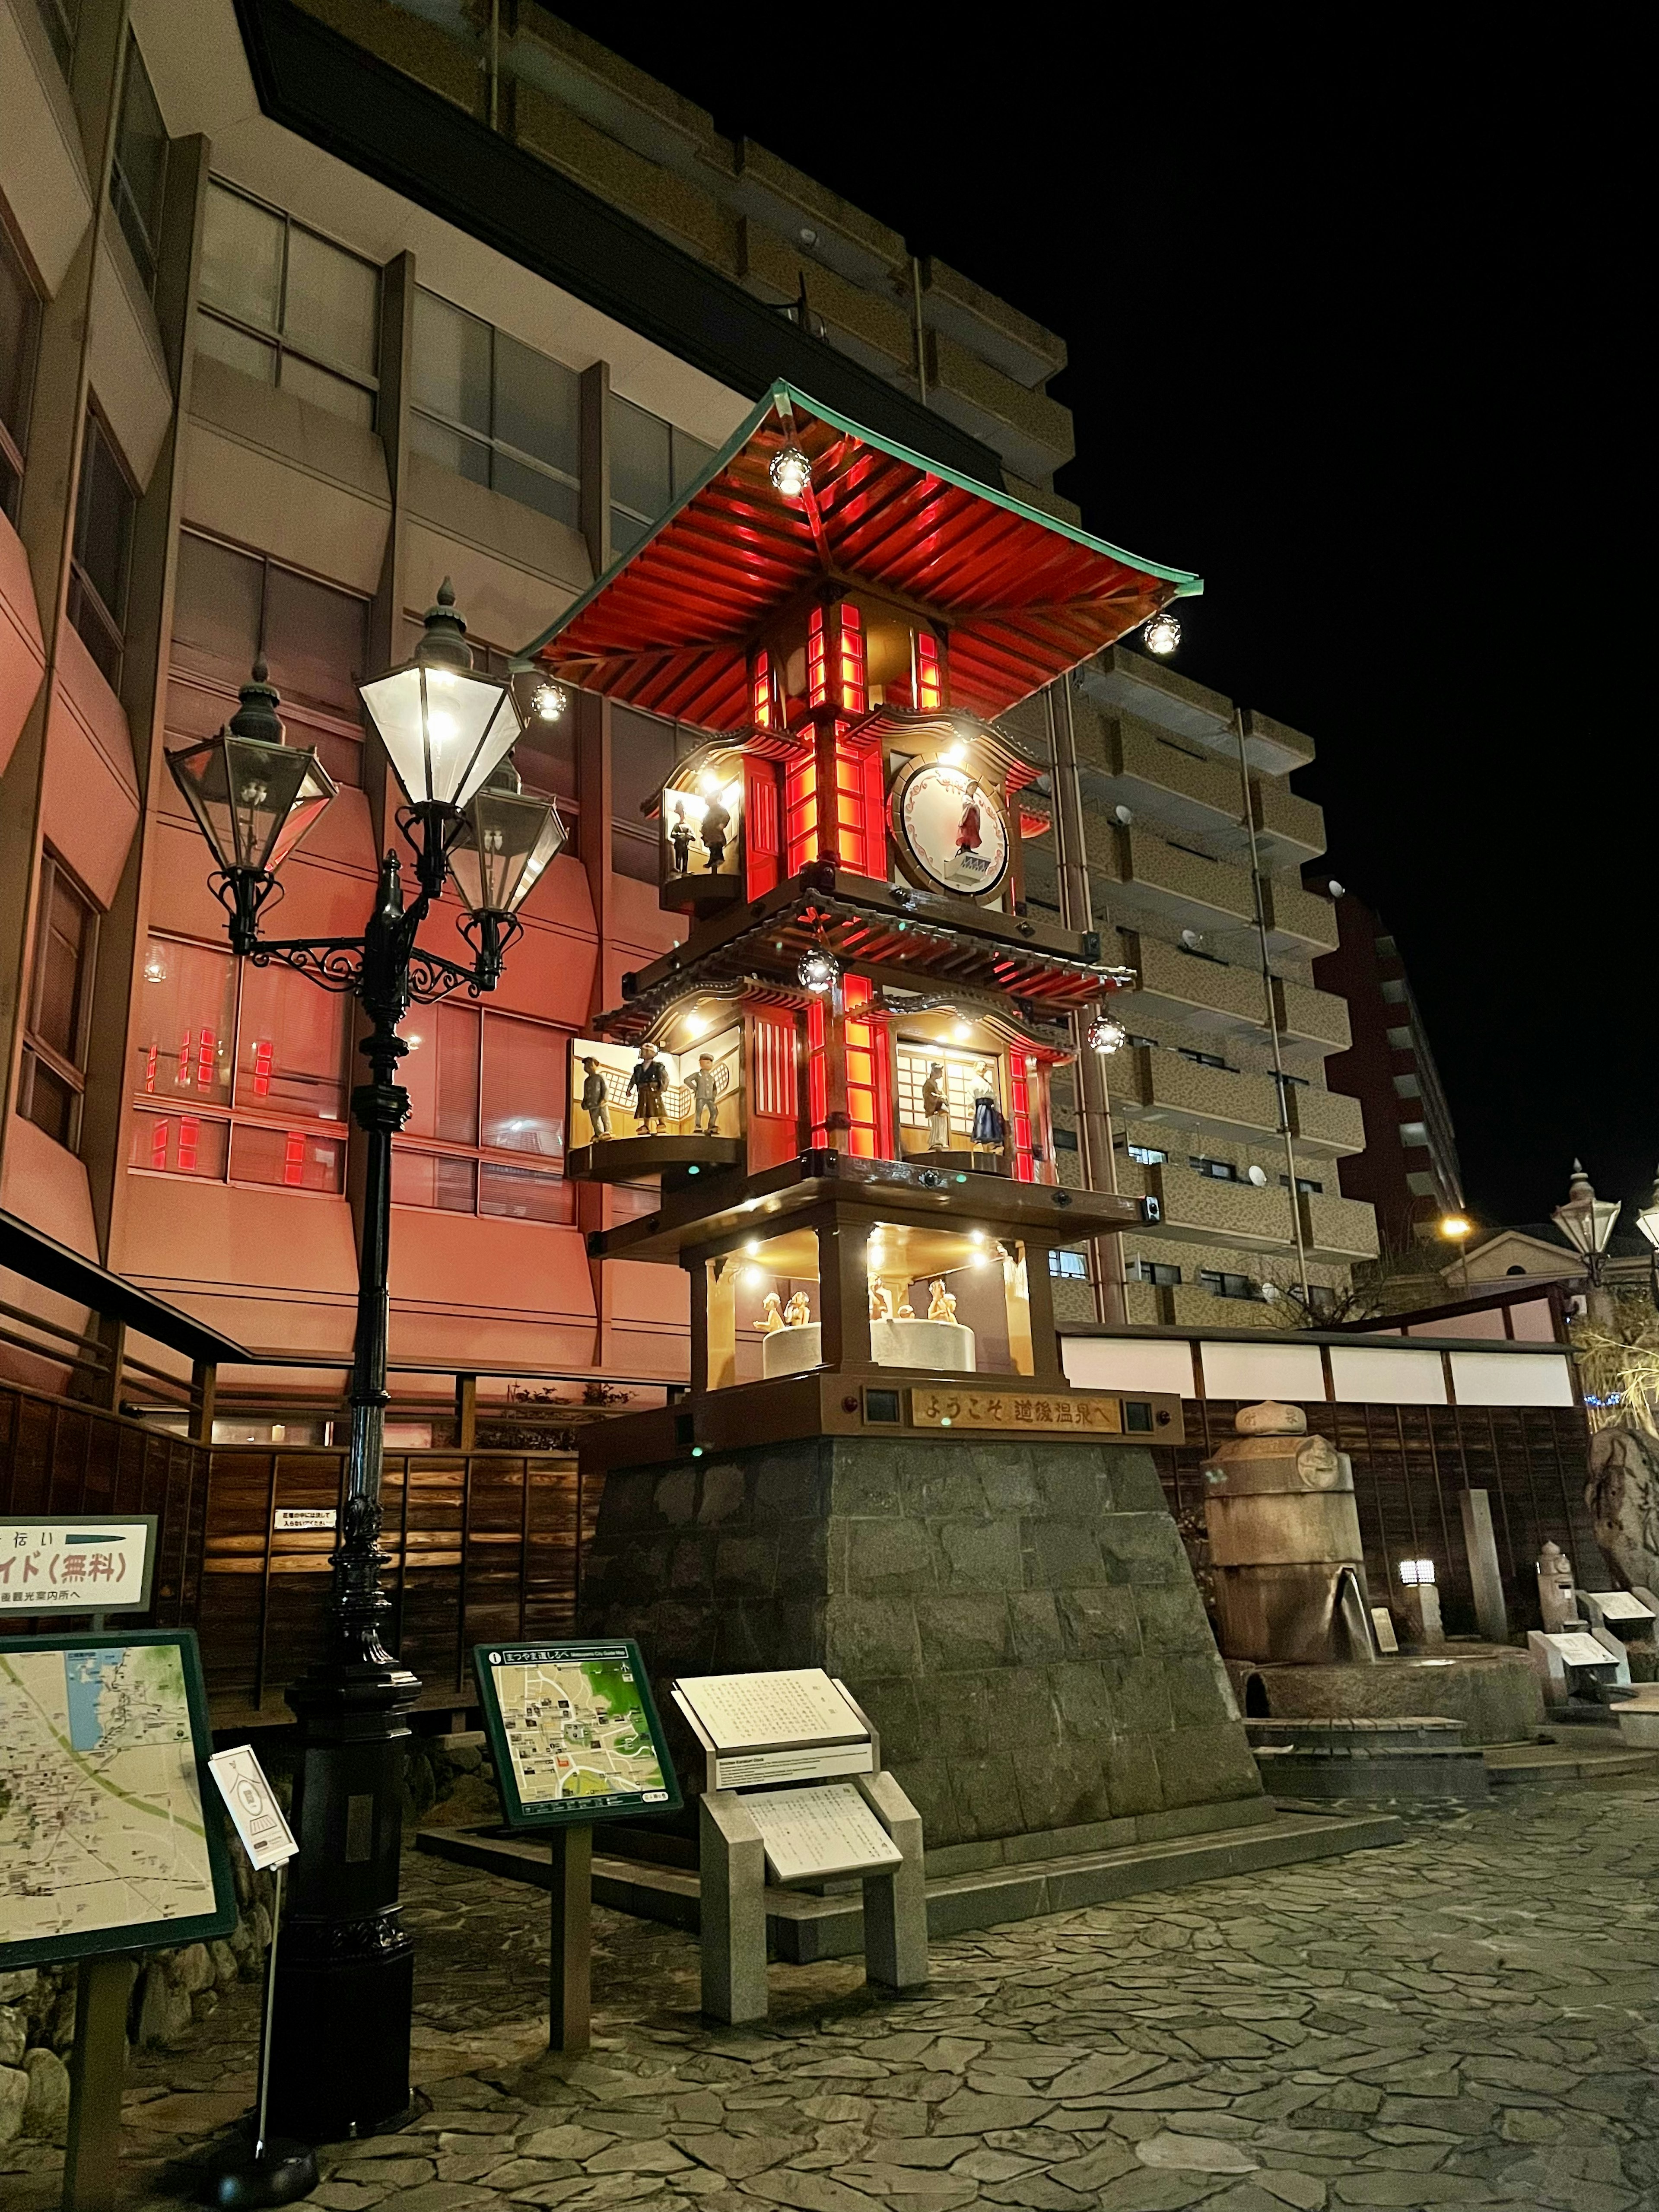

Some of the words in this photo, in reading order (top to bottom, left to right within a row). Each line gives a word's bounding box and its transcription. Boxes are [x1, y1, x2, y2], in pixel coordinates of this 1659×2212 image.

[925, 1395, 1004, 1422] ようこそ
[1014, 1399, 1111, 1425] 道後温泉へ
[0, 1532, 53, 1548] 伝い
[506, 1650, 569, 1662] まつやま道しるべ
